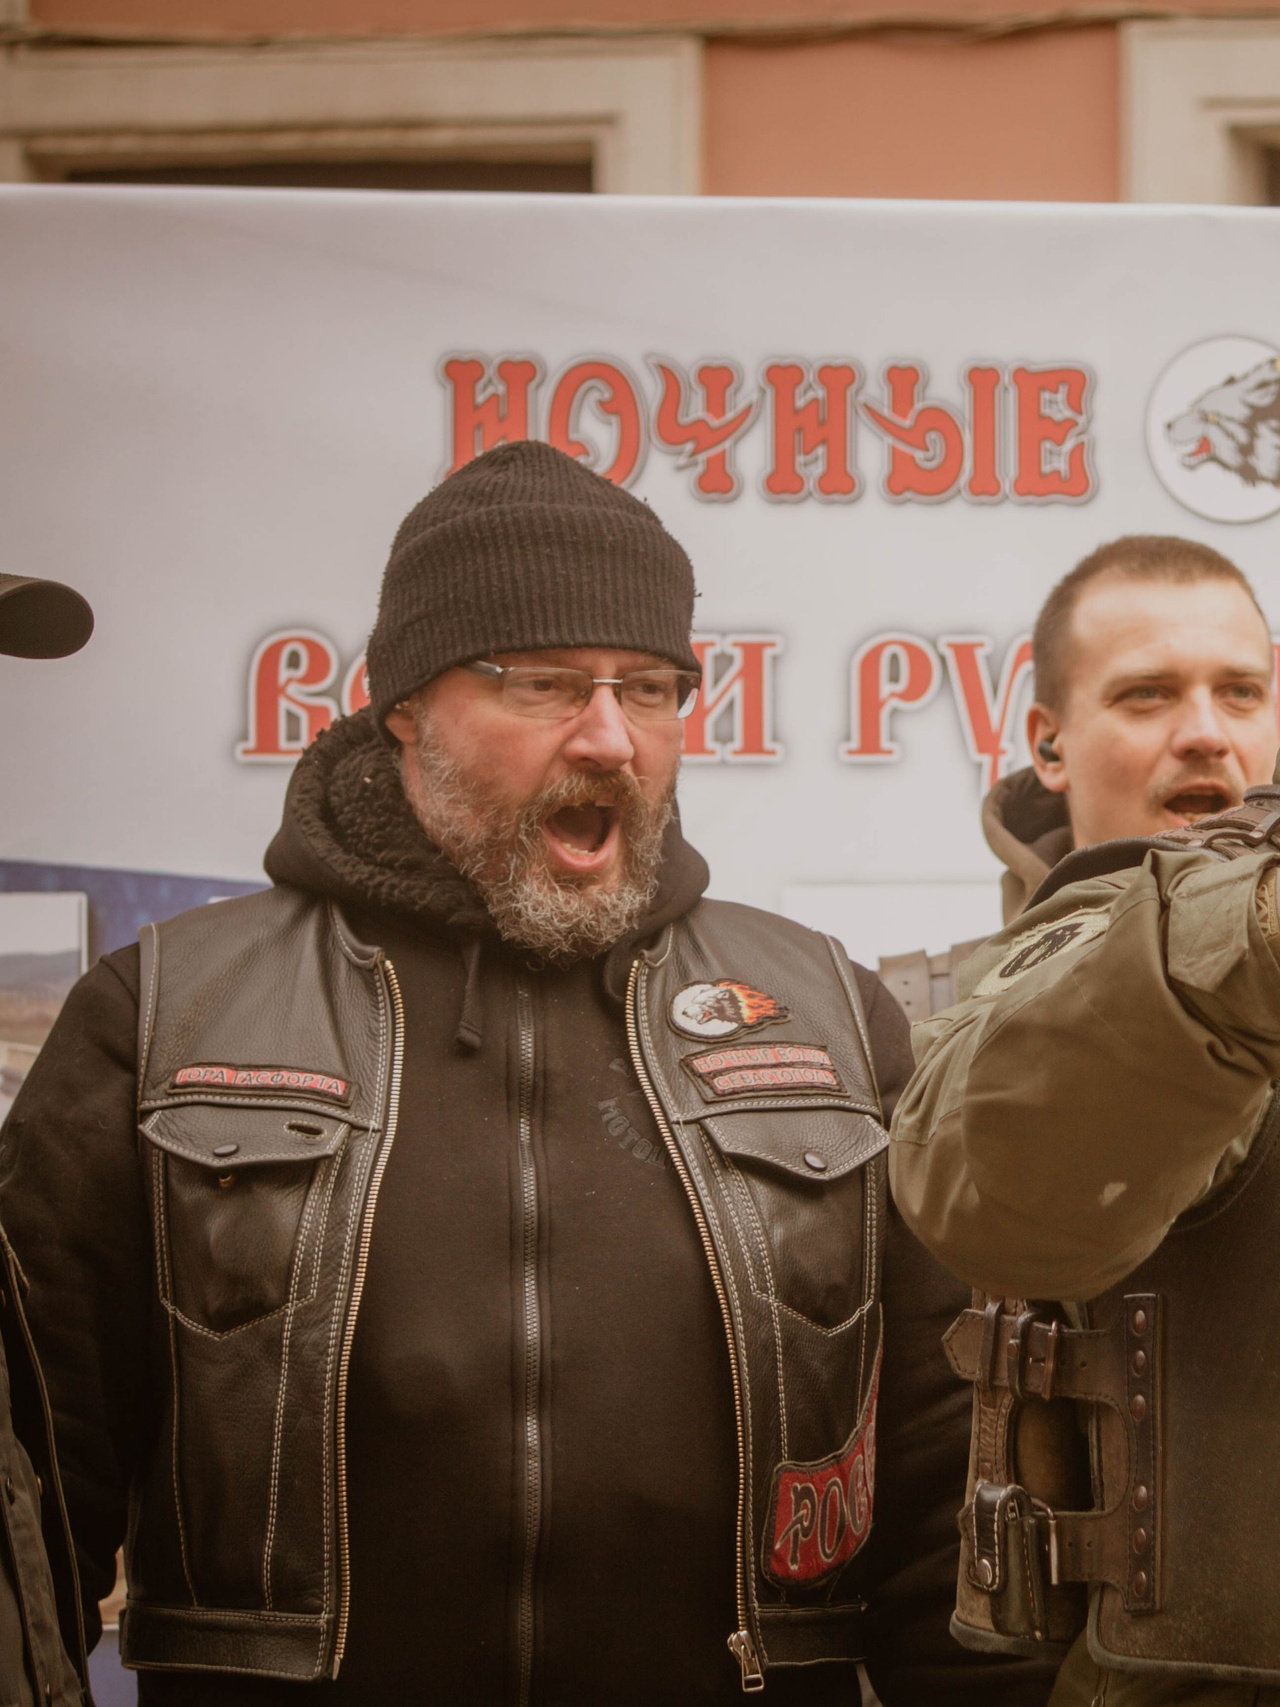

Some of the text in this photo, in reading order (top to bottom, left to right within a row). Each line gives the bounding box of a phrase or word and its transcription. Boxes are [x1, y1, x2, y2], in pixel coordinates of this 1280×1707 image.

[442, 357, 1091, 499] НОЧНЫЕ
[177, 1067, 345, 1096] ГОРА ГАСФОРТА
[714, 1067, 838, 1090] СЕВАСТОПОЛЬ
